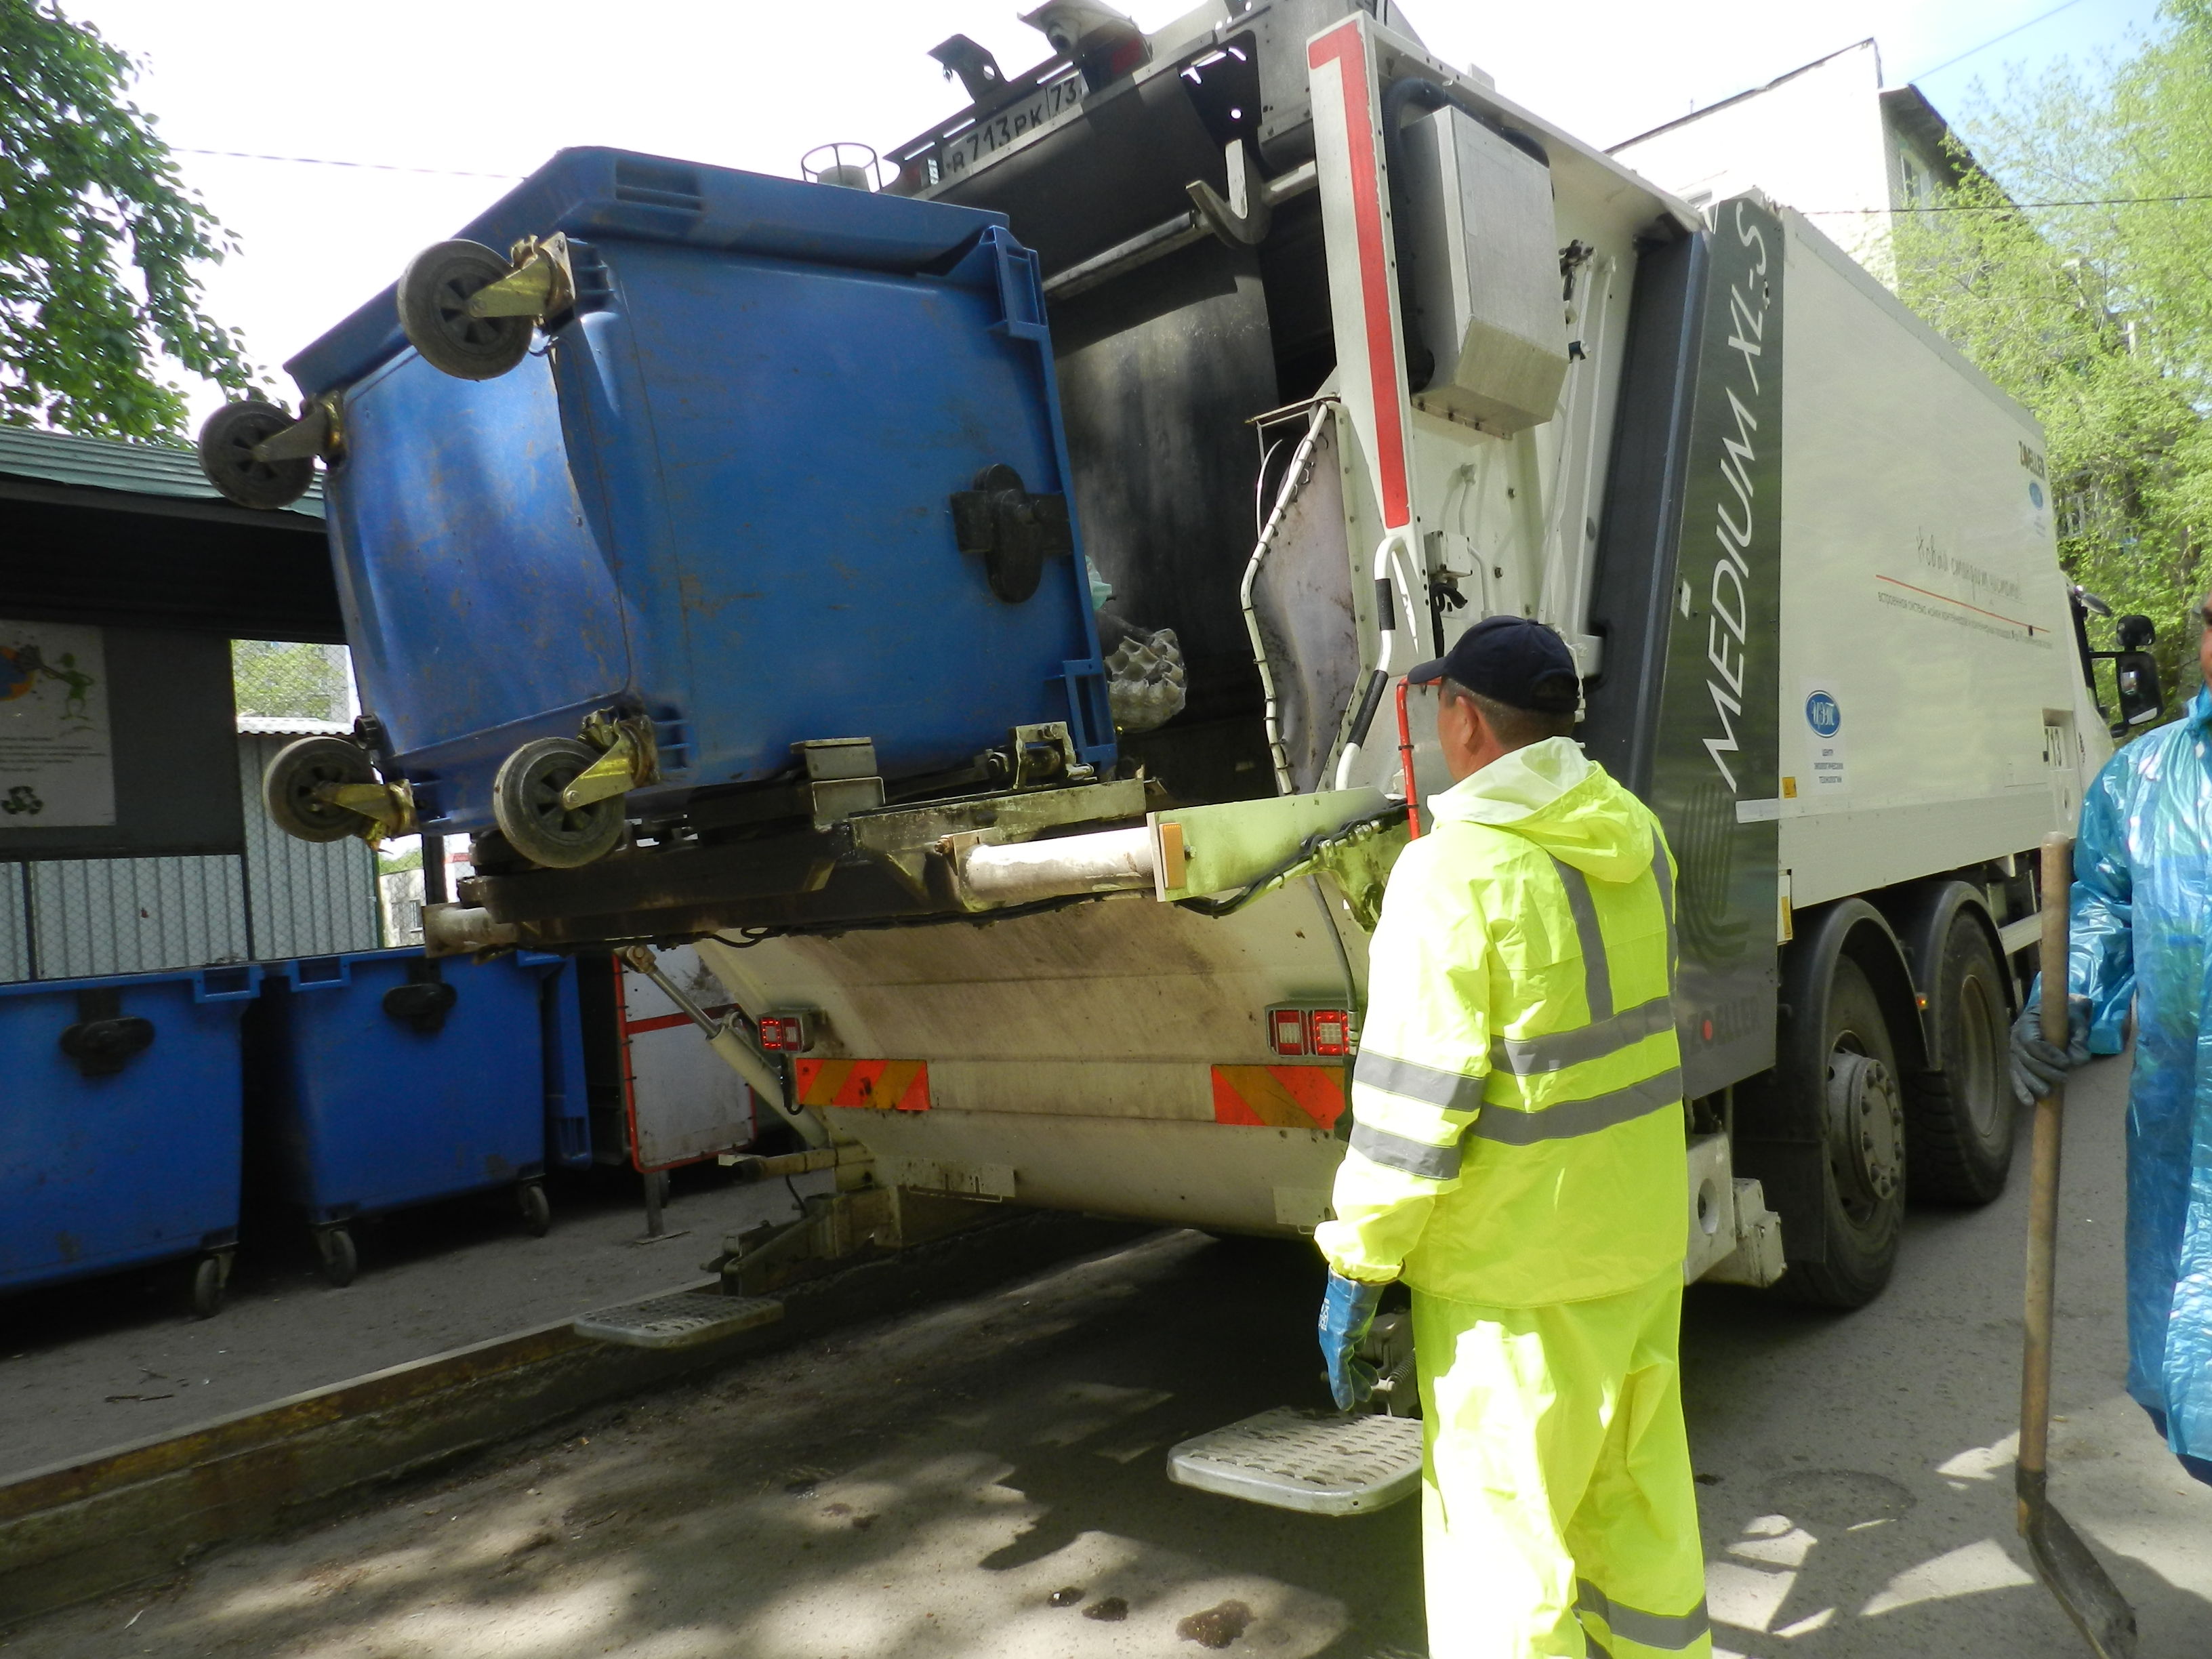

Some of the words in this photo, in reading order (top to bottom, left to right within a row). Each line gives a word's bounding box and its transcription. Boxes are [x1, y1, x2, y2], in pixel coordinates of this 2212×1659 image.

[1050, 79, 1078, 113] 73
[1728, 201, 1767, 396] XL-S
[1702, 386, 1757, 793] MEDIUM
